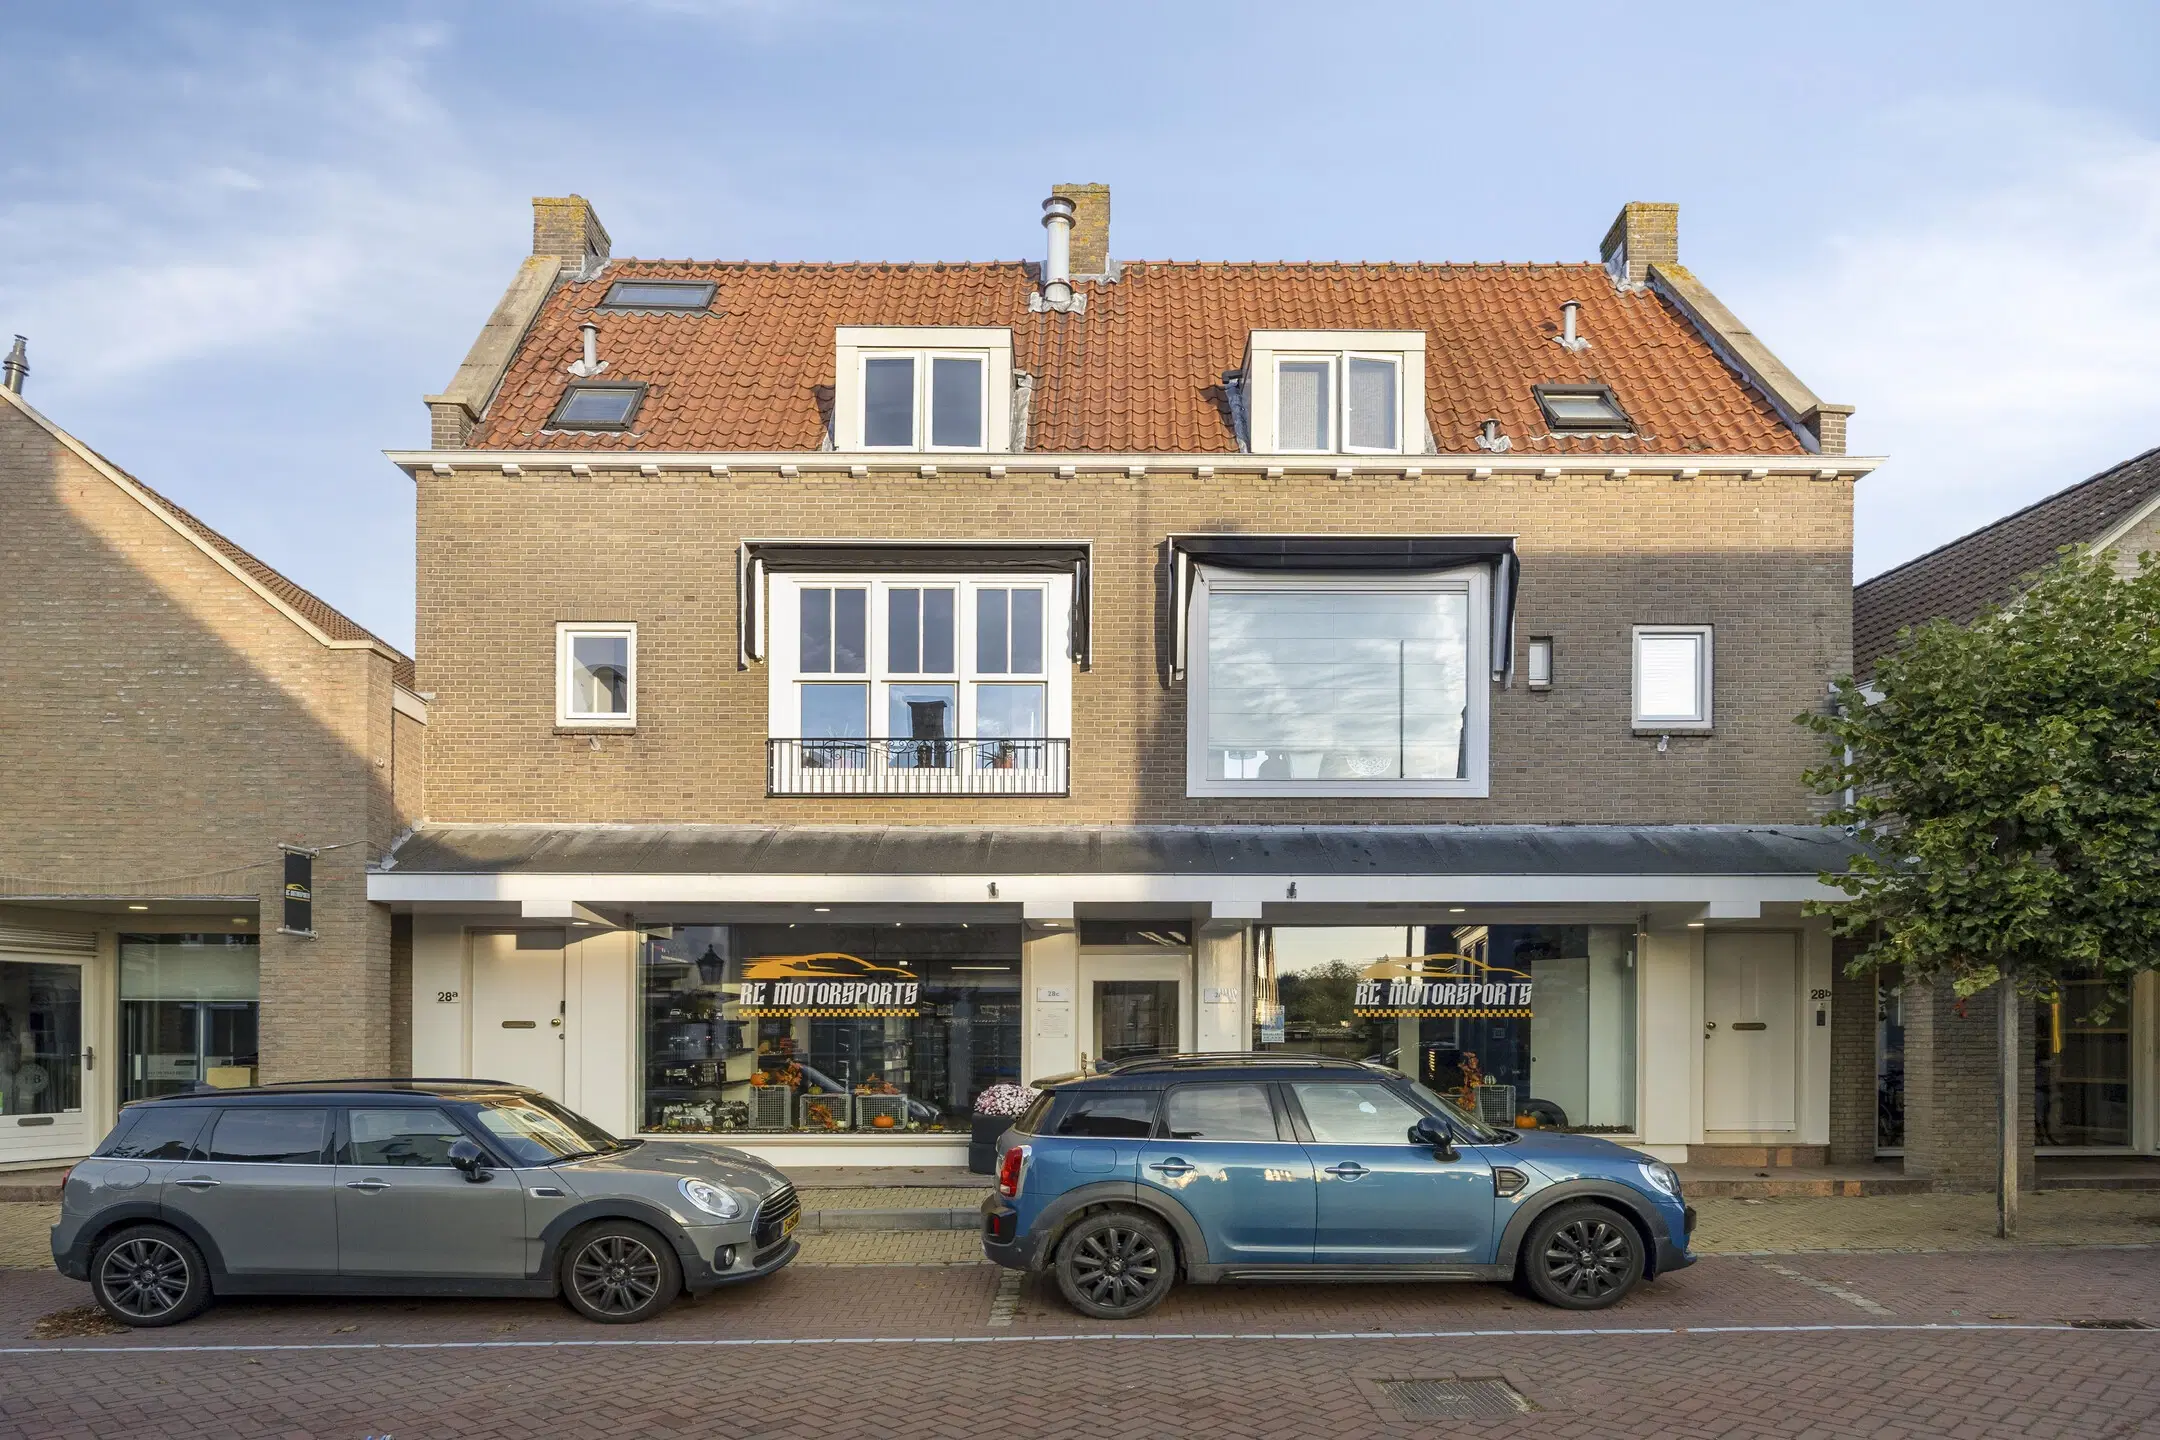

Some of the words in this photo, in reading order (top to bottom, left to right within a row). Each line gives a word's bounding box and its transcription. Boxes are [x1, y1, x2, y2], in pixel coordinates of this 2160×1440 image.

[739, 982, 767, 1005] RC
[773, 982, 918, 1005] MOTORSPORTS
[1354, 983, 1382, 1006] RC
[1388, 983, 1533, 1006] MOTORSPORTS
[1810, 988, 1832, 1000] 28b
